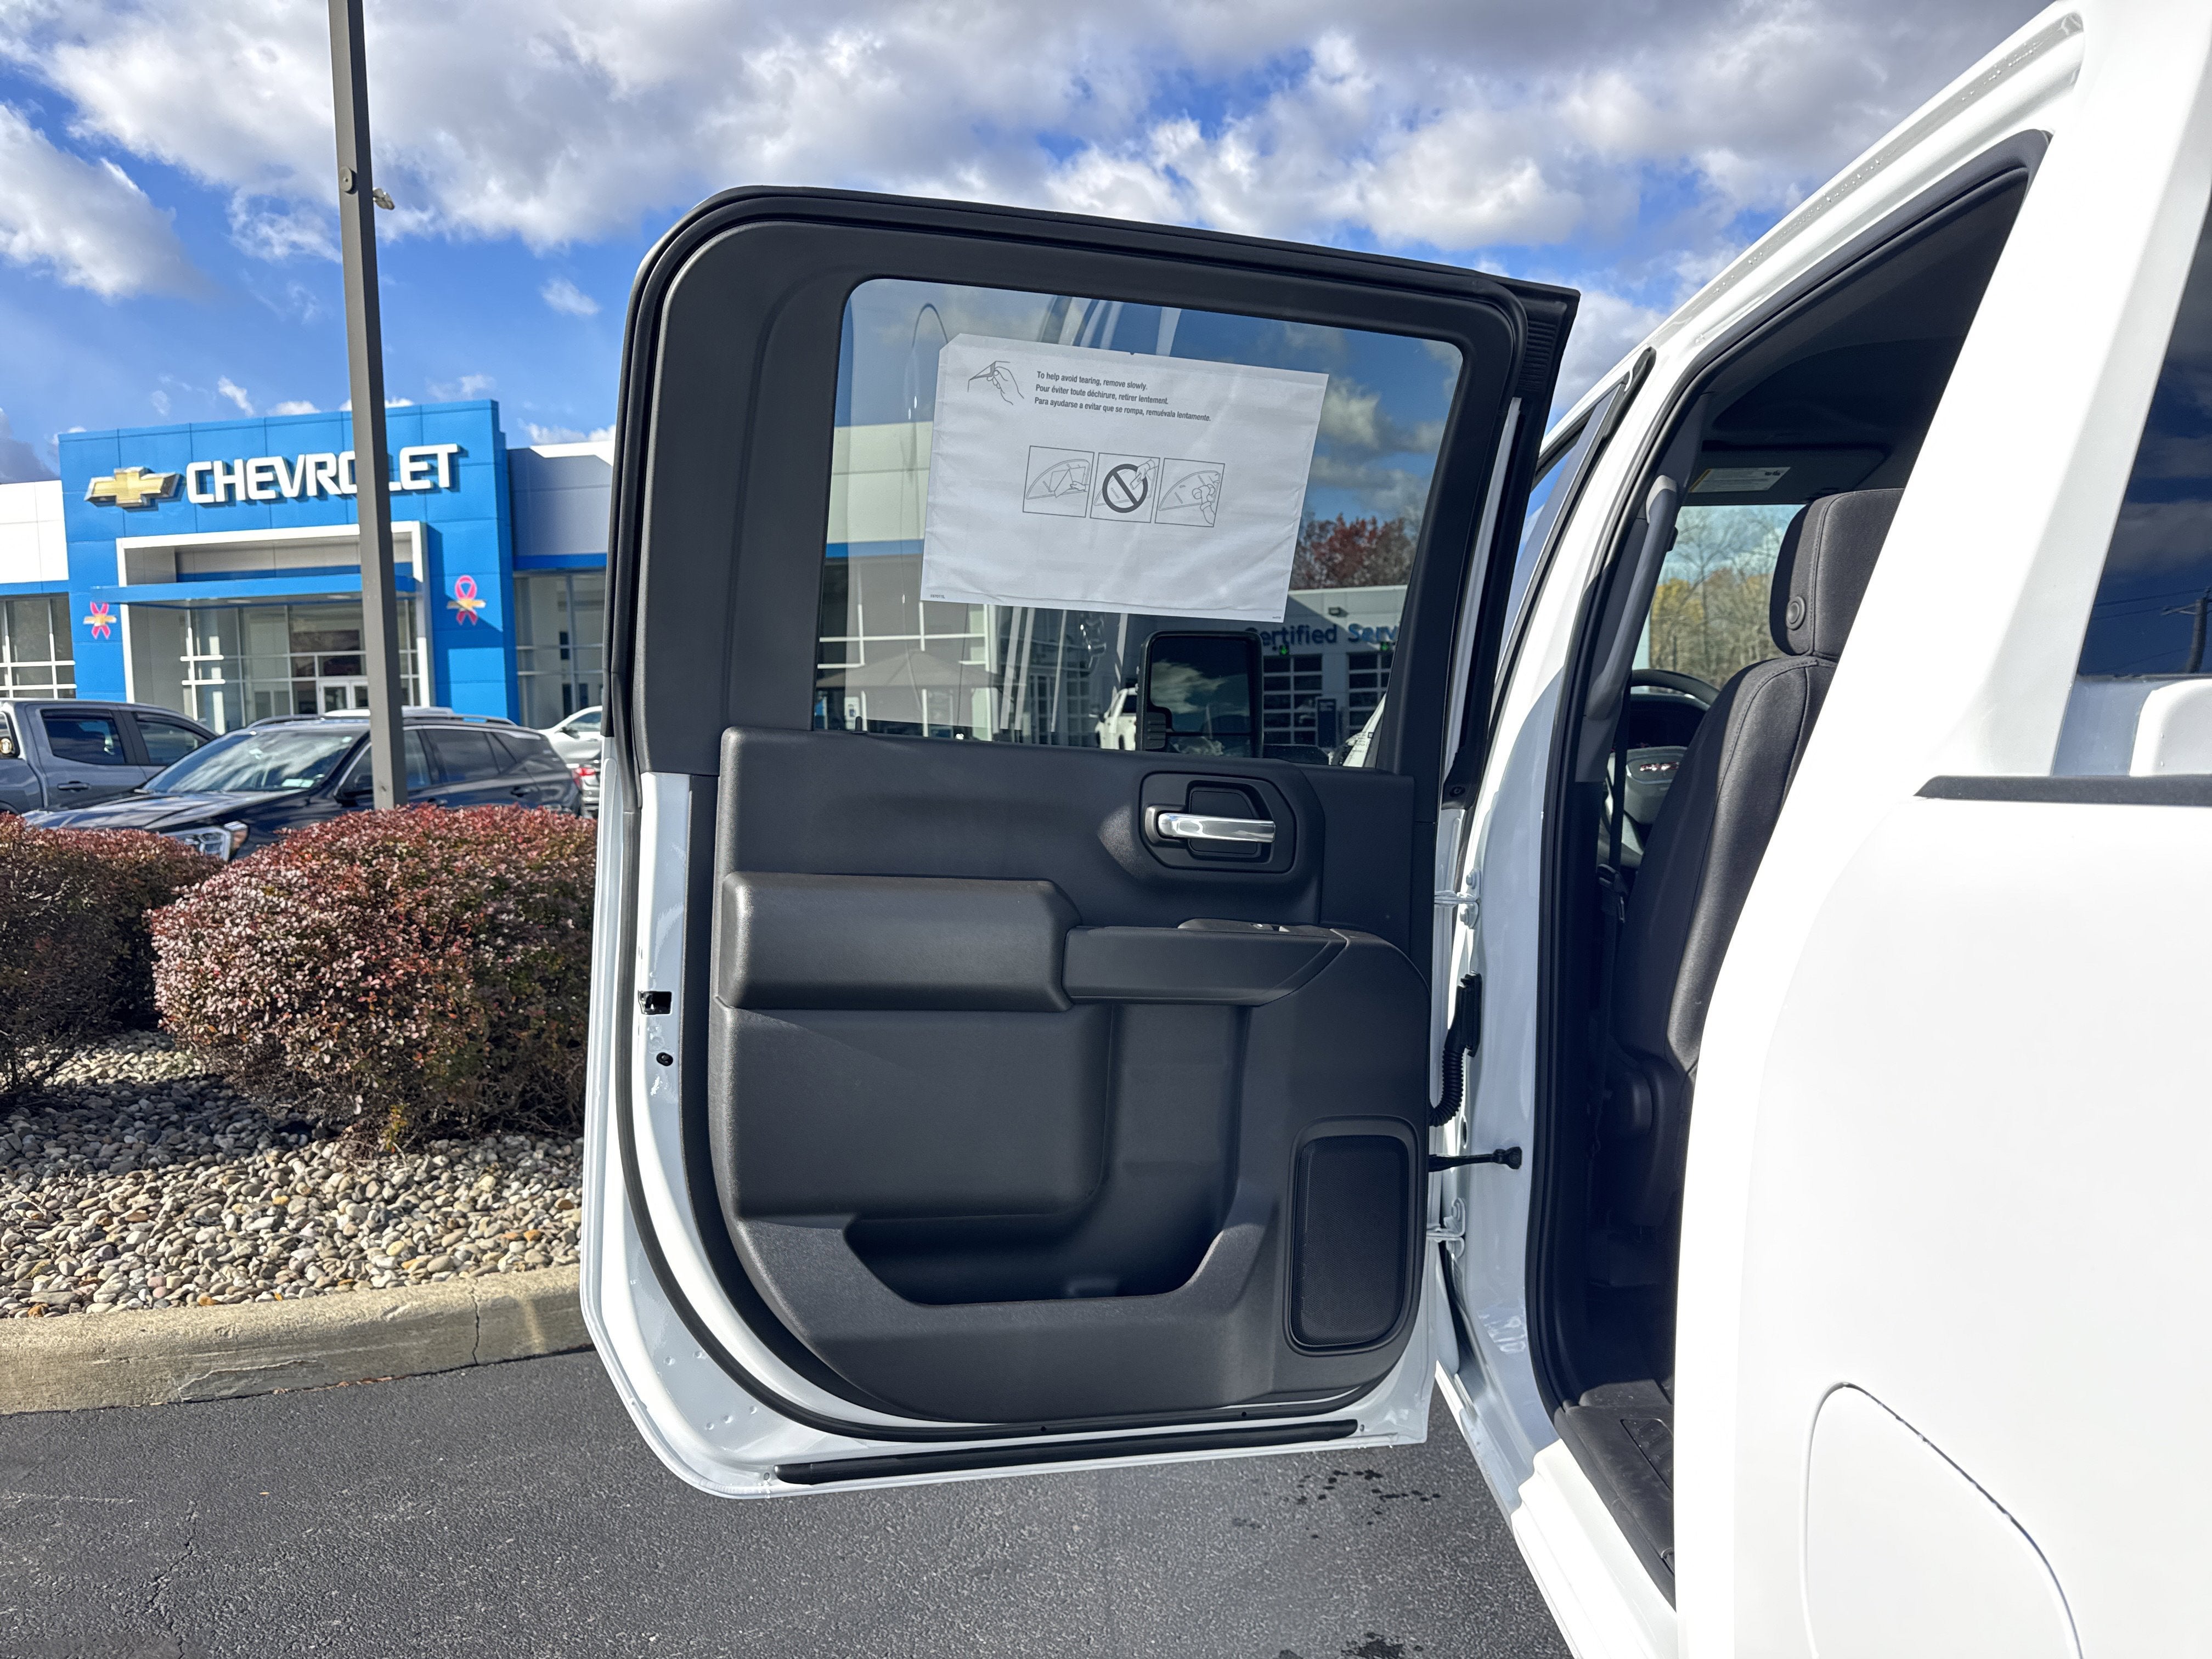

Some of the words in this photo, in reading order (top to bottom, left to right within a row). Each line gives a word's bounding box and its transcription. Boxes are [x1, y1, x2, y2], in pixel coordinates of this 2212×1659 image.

[1046, 372, 1059, 381] help
[1079, 376, 1102, 386] tearing,
[1103, 379, 1125, 387] remove
[1127, 381, 1148, 391] slowly.
[1036, 384, 1050, 392] Pour
[1051, 385, 1069, 394] éviter
[1070, 387, 1086, 396] toute
[1087, 390, 1117, 400] déchirure,
[1119, 393, 1137, 402] retirer
[1035, 397, 1048, 405] Para
[1050, 399, 1077, 408] ayudarse
[1124, 407, 1144, 416] rompa,
[1146, 409, 1176, 417] remuévala
[1177, 411, 1211, 422] lentamente.
[186, 443, 459, 504] CHEVROET
[1245, 624, 1338, 646] ertified
